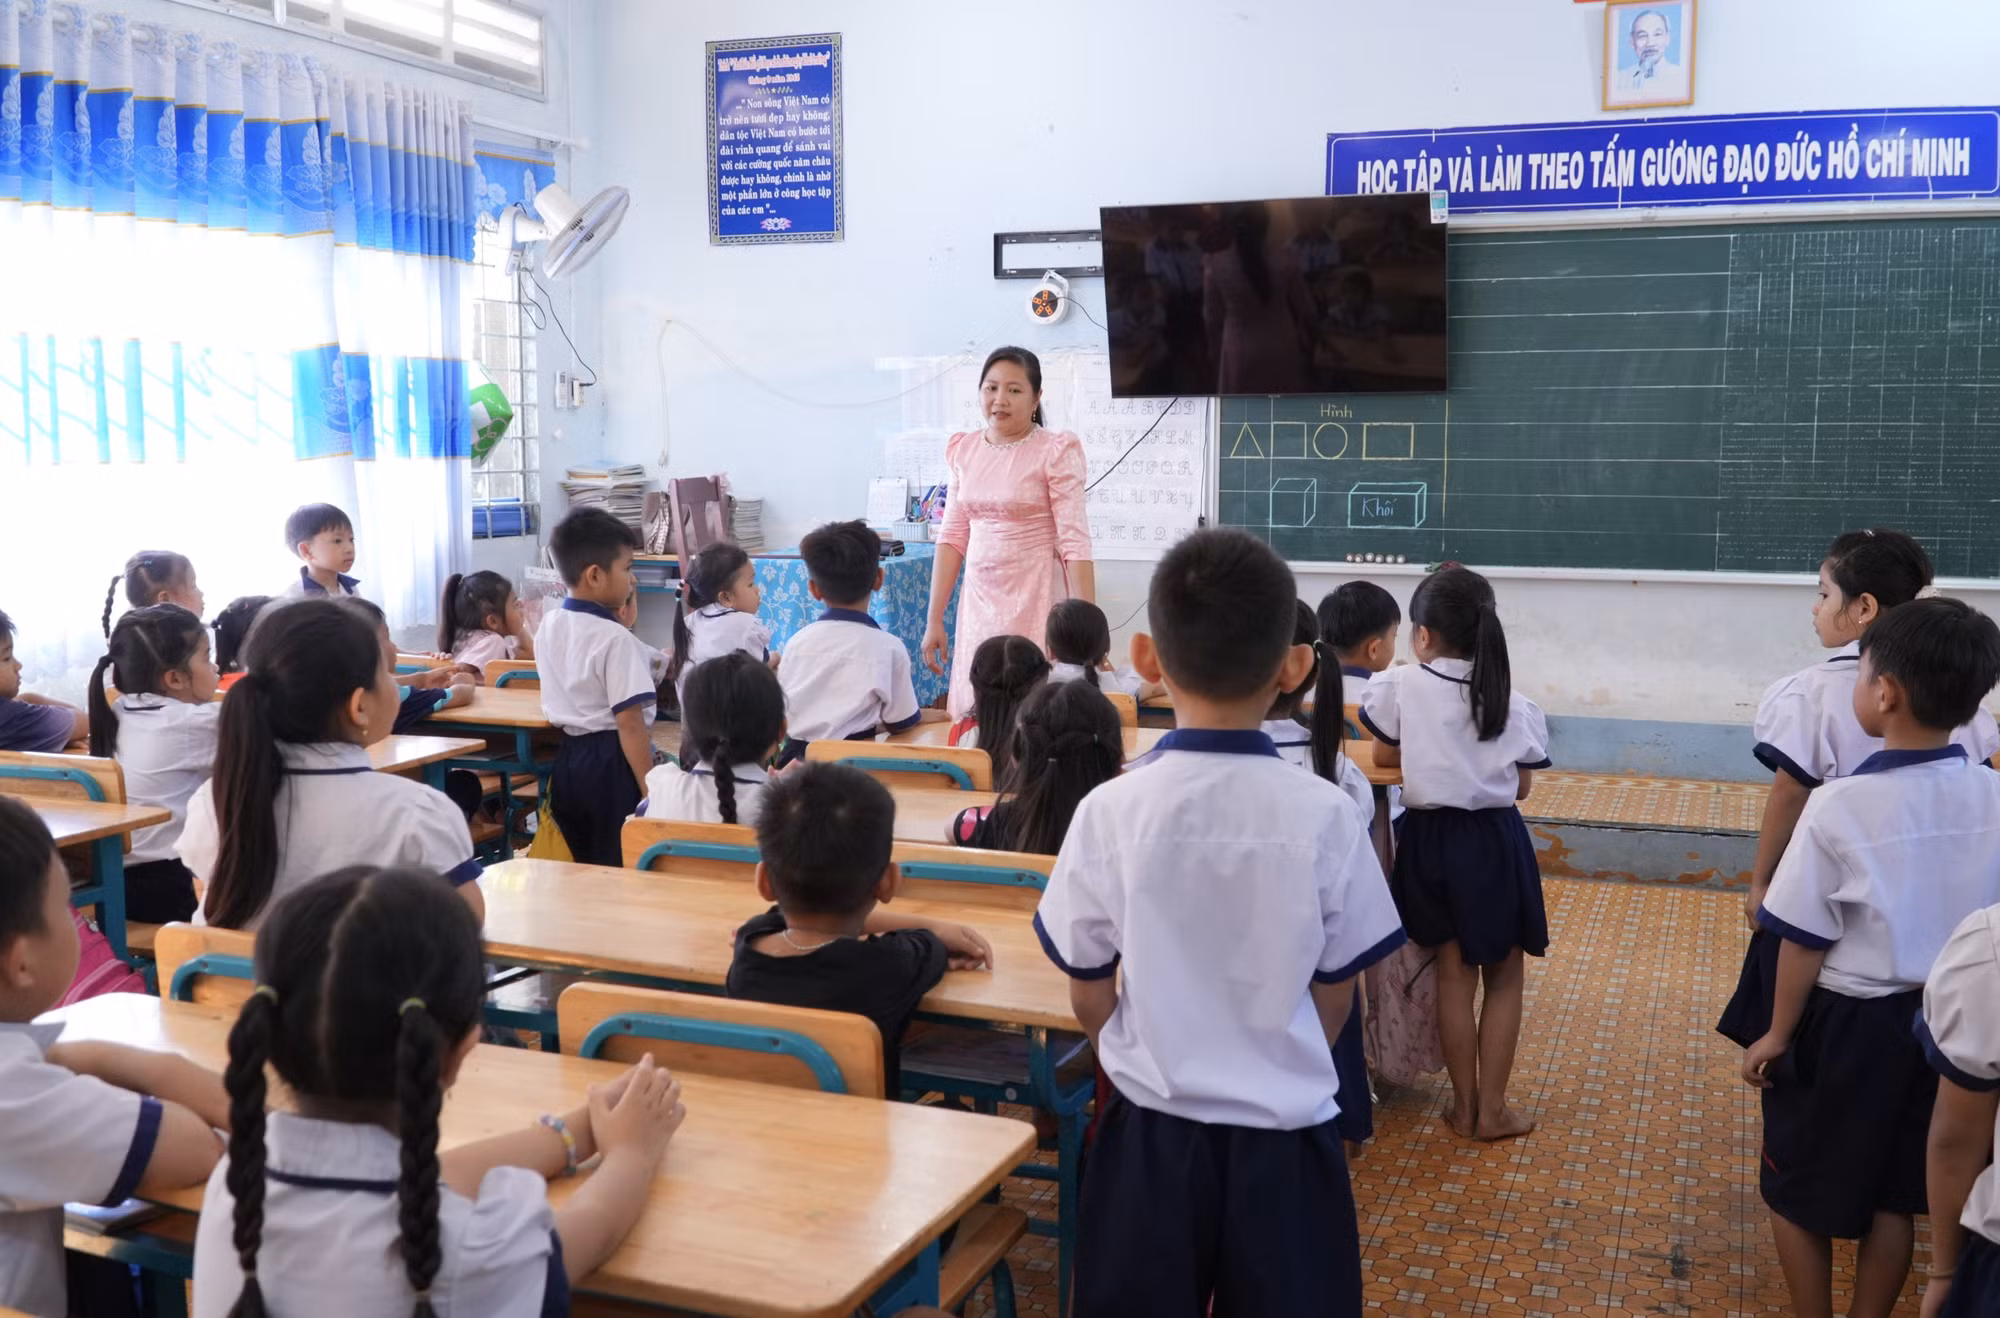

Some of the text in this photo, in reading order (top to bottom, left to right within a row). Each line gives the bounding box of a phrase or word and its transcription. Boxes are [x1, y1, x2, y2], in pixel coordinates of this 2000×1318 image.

[747, 98, 762, 108] Non
[764, 98, 782, 109] sông
[784, 95, 799, 107] Việt
[801, 95, 819, 105] Nam
[821, 93, 830, 104] có
[720, 114, 731, 125] trở
[734, 115, 749, 124] nên
[769, 112, 784, 124] đẹp
[786, 111, 800, 123] hay
[720, 131, 735, 140] dân
[736, 130, 749, 141] tộc
[750, 128, 766, 140] Việt
[768, 127, 785, 138] Nam
[787, 126, 796, 137] có
[799, 126, 817, 136] bước
[720, 145, 733, 155] đài
[735, 144, 754, 154] vinh
[756, 144, 781, 156] quang
[796, 140, 815, 151] sánh
[818, 140, 831, 150] vai
[721, 156, 831, 171] với các cường quốc năm châu
[1448, 146, 1474, 193] VÀ
[1481, 144, 1523, 192] LÀM
[1528, 151, 1584, 191] THEO
[1590, 133, 1635, 187] TẤM
[1641, 139, 1717, 187] GƯƠNG
[1723, 142, 1770, 194] ĐẠO
[1775, 130, 1821, 181] ĐỨC
[1827, 122, 1860, 179] HỒ
[1866, 128, 1906, 178] CHÍ
[1912, 137, 1970, 177] MINH
[721, 175, 739, 187] được
[741, 174, 755, 186] hay
[784, 172, 805, 182] chính
[807, 171, 814, 181] là
[721, 190, 736, 202] một
[781, 187, 800, 199] công
[802, 186, 816, 199] học
[818, 186, 831, 198] tập
[722, 205, 736, 215] của
[738, 205, 751, 215] các
[1320, 403, 1353, 419] Hình
[1362, 497, 1398, 518] Khối
